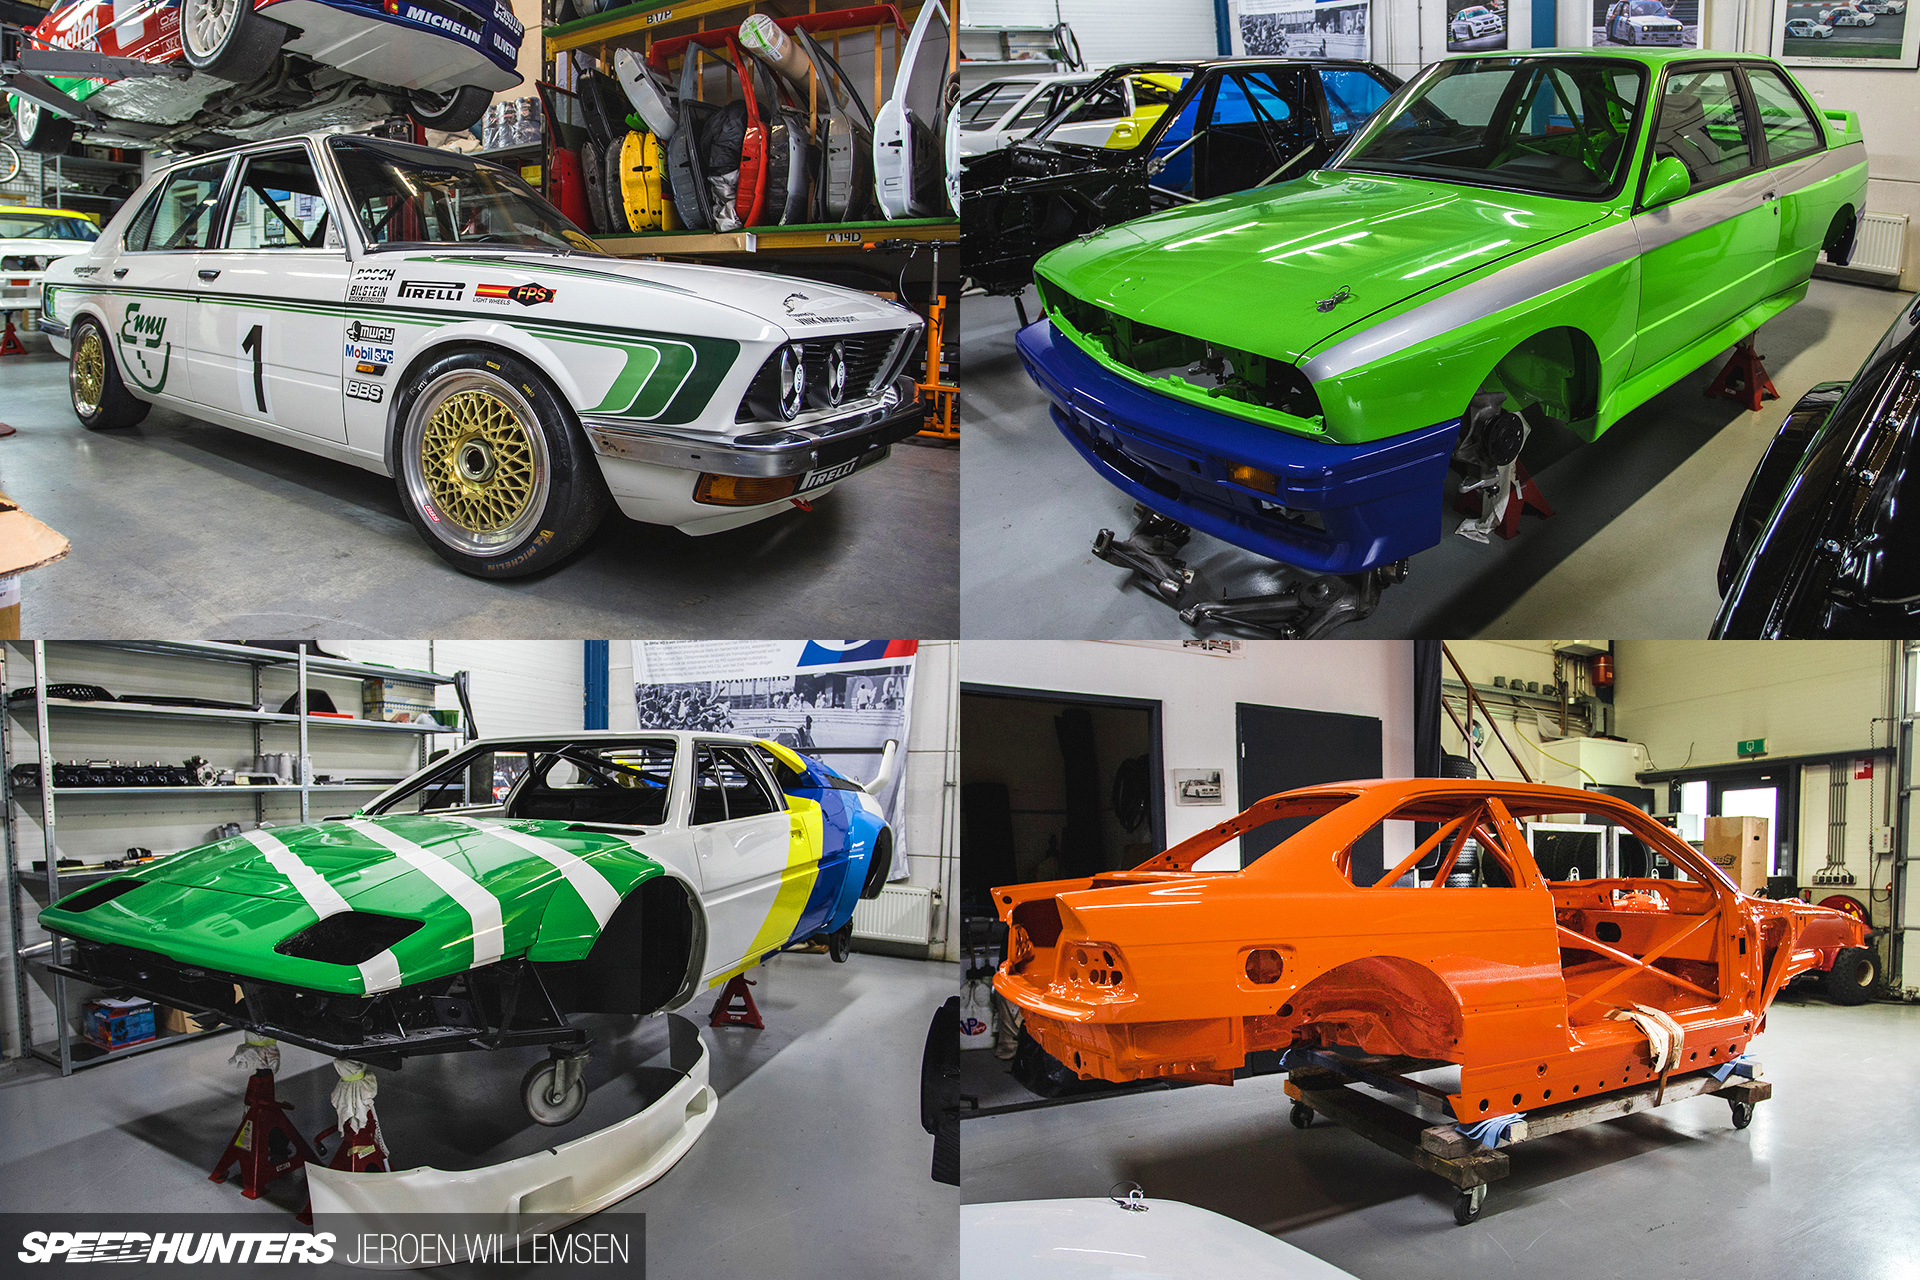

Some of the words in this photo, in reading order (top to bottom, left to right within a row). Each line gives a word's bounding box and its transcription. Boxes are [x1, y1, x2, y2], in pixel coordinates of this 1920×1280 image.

[406, 5, 481, 45] MICHELIN
[493, 32, 517, 60] ULIVETO
[355, 268, 396, 281] BOSCH
[350, 285, 389, 298] BILSTEIN
[397, 280, 467, 301] PIRELLI
[517, 286, 547, 302] FPS
[345, 344, 373, 361] Mobil
[242, 324, 268, 413] 1
[347, 382, 383, 402] BBS
[799, 456, 860, 491] PIRELLI
[487, 545, 537, 572] MICHELIN
